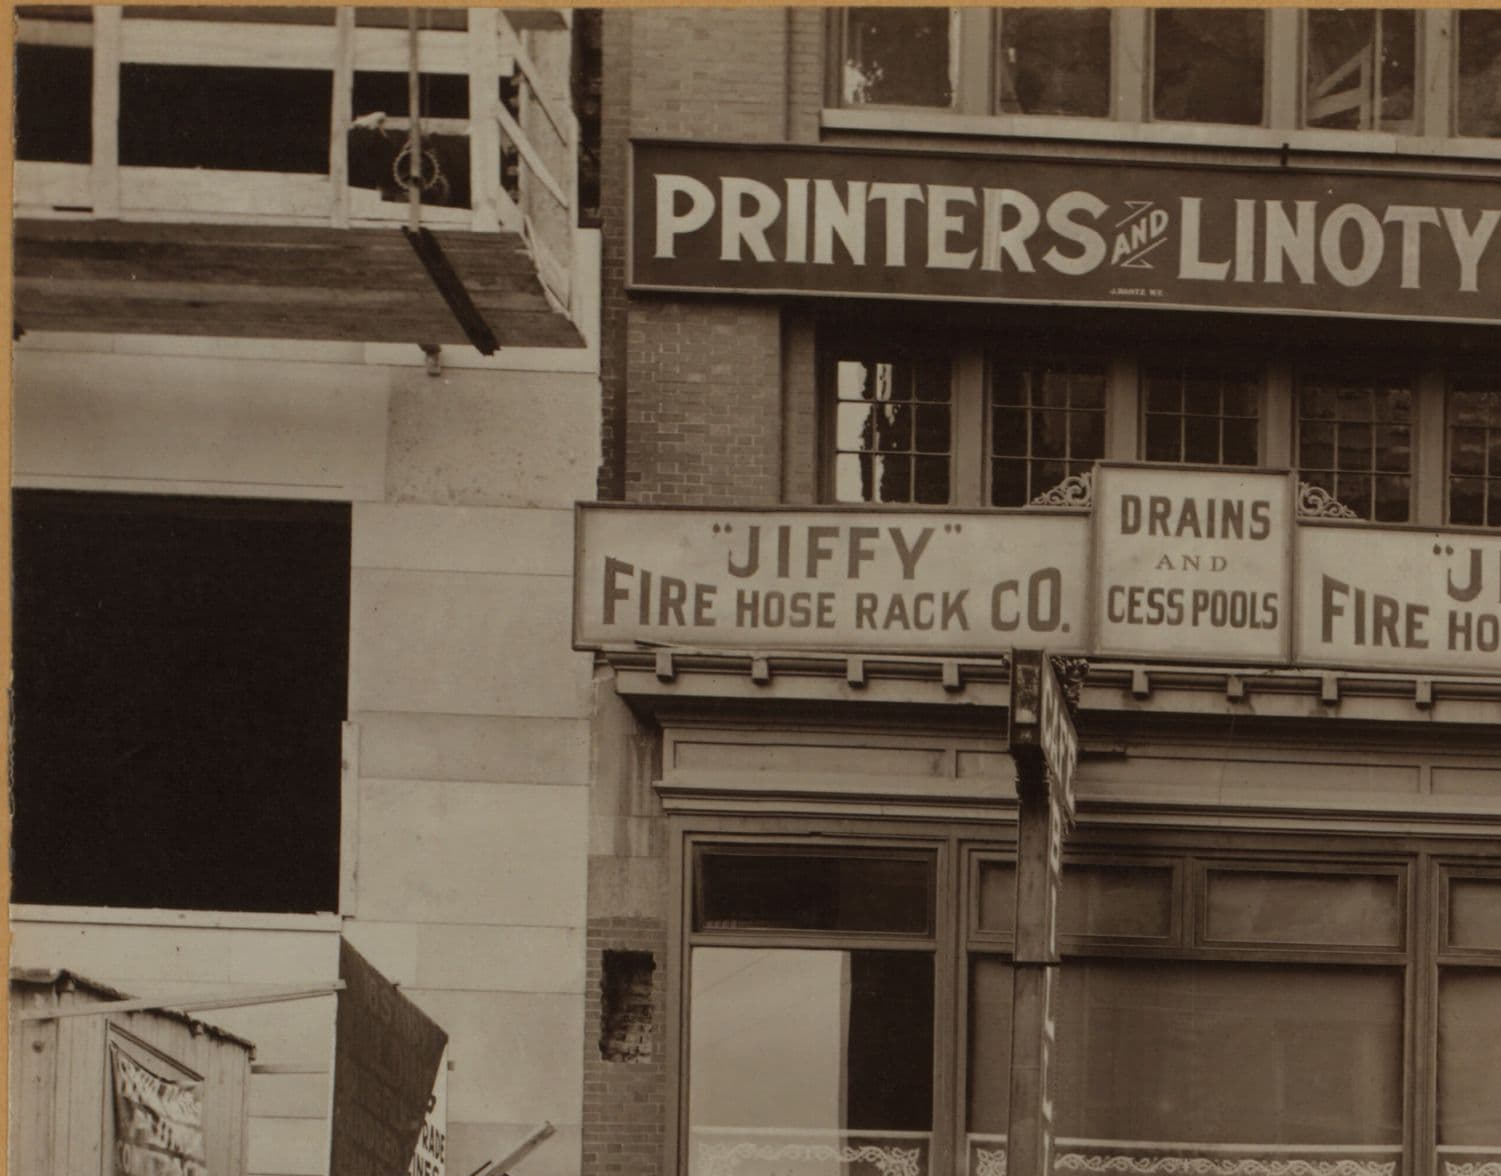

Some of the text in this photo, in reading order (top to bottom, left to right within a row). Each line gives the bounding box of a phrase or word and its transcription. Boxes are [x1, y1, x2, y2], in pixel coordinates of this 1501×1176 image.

[653, 174, 1110, 276] PRINTERS
[1111, 209, 1169, 265] AND
[1119, 494, 1272, 541] DRAINS
[712, 523, 963, 580] "JIFFY"
[1155, 553, 1229, 573] AND
[602, 556, 1071, 634] FIRE HOSE RACK CO.
[1107, 584, 1280, 631] CESS POOLS
[1321, 573, 1429, 650] FIRE
